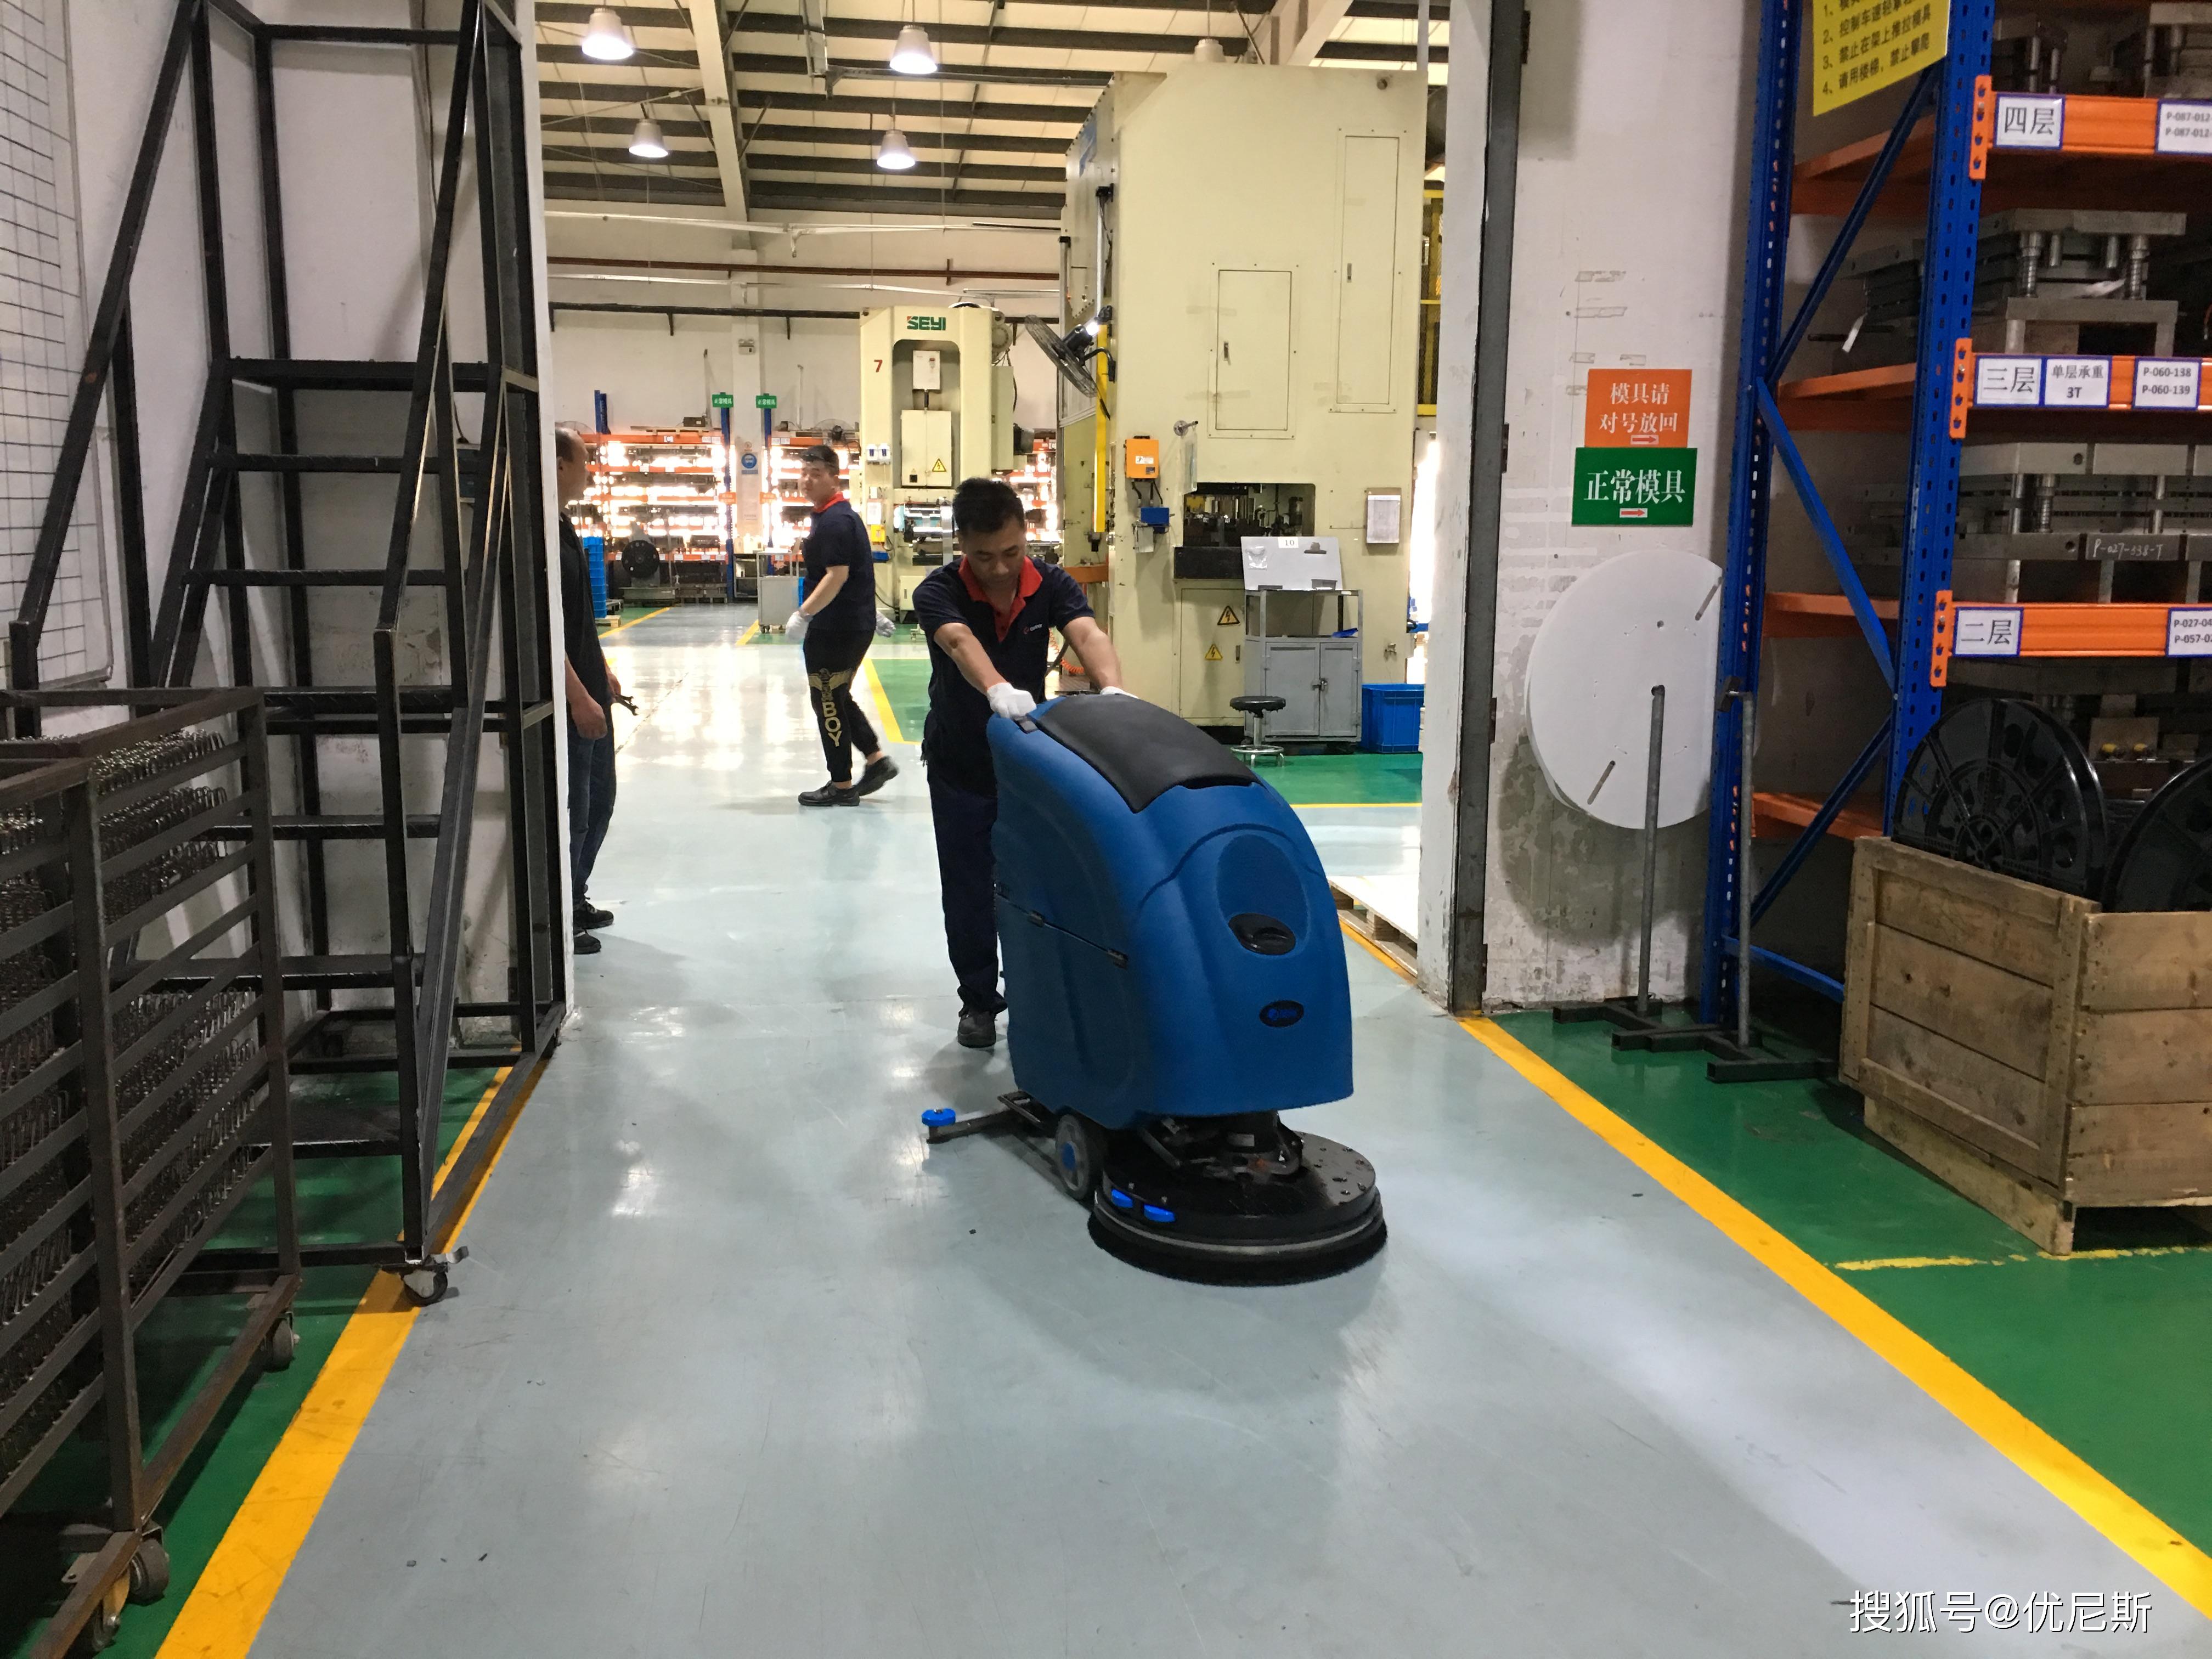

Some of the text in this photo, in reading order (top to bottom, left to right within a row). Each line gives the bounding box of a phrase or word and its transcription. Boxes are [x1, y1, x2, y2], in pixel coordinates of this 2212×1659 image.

[2004, 106, 2055, 135] 四层
[906, 315, 946, 331] SEYI
[873, 359, 883, 373] 7
[2052, 364, 2104, 379] 单层承重
[2143, 366, 2192, 377] P-060-138
[1983, 366, 2035, 393] 三层
[1610, 382, 1670, 405] 模具请
[2067, 386, 2083, 399] 3T
[2142, 384, 2191, 395] P-060-139
[1599, 411, 1678, 434] 对号放回
[1584, 469, 1685, 504] 正常模具
[1285, 539, 1295, 547] 10
[1961, 619, 2012, 645] 二层
[822, 701, 842, 747] BOY
